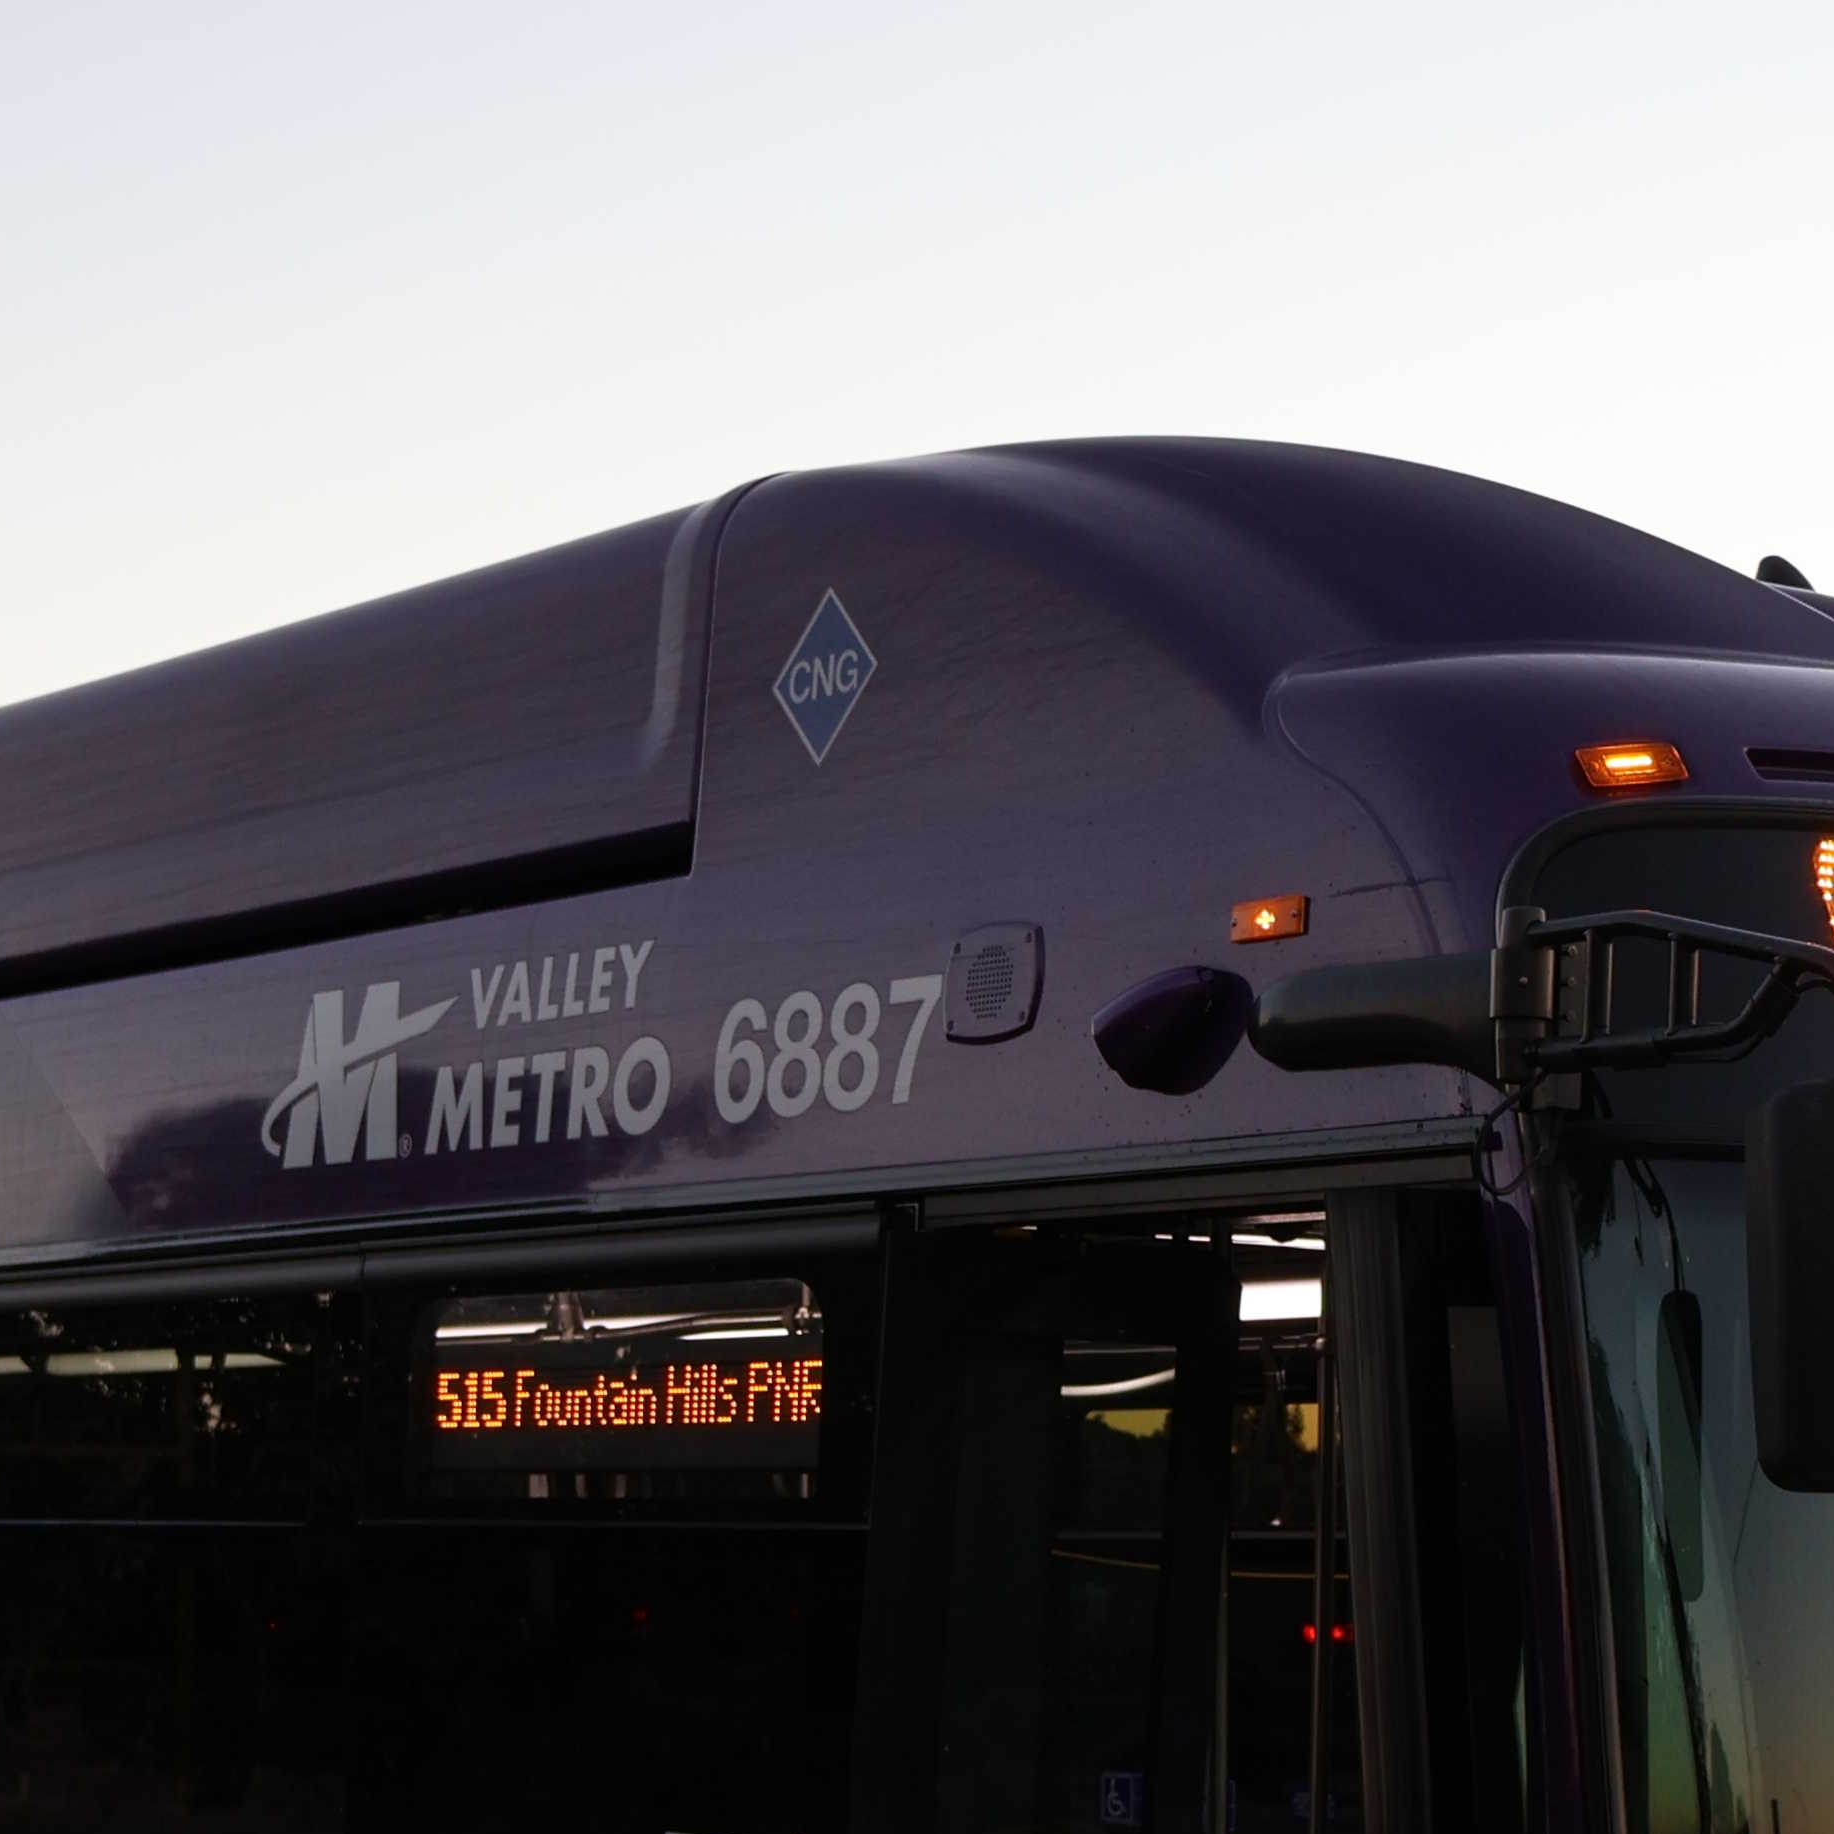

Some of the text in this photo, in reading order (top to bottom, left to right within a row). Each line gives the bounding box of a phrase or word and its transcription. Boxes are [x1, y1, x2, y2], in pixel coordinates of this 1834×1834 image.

[788, 648, 859, 706] CNG
[470, 939, 654, 1031] VALLEY
[424, 973, 944, 1156] METRO 6887
[437, 1371, 507, 1428] 515
[515, 1370, 657, 1427] Fountain
[666, 1363, 738, 1424] Hills
